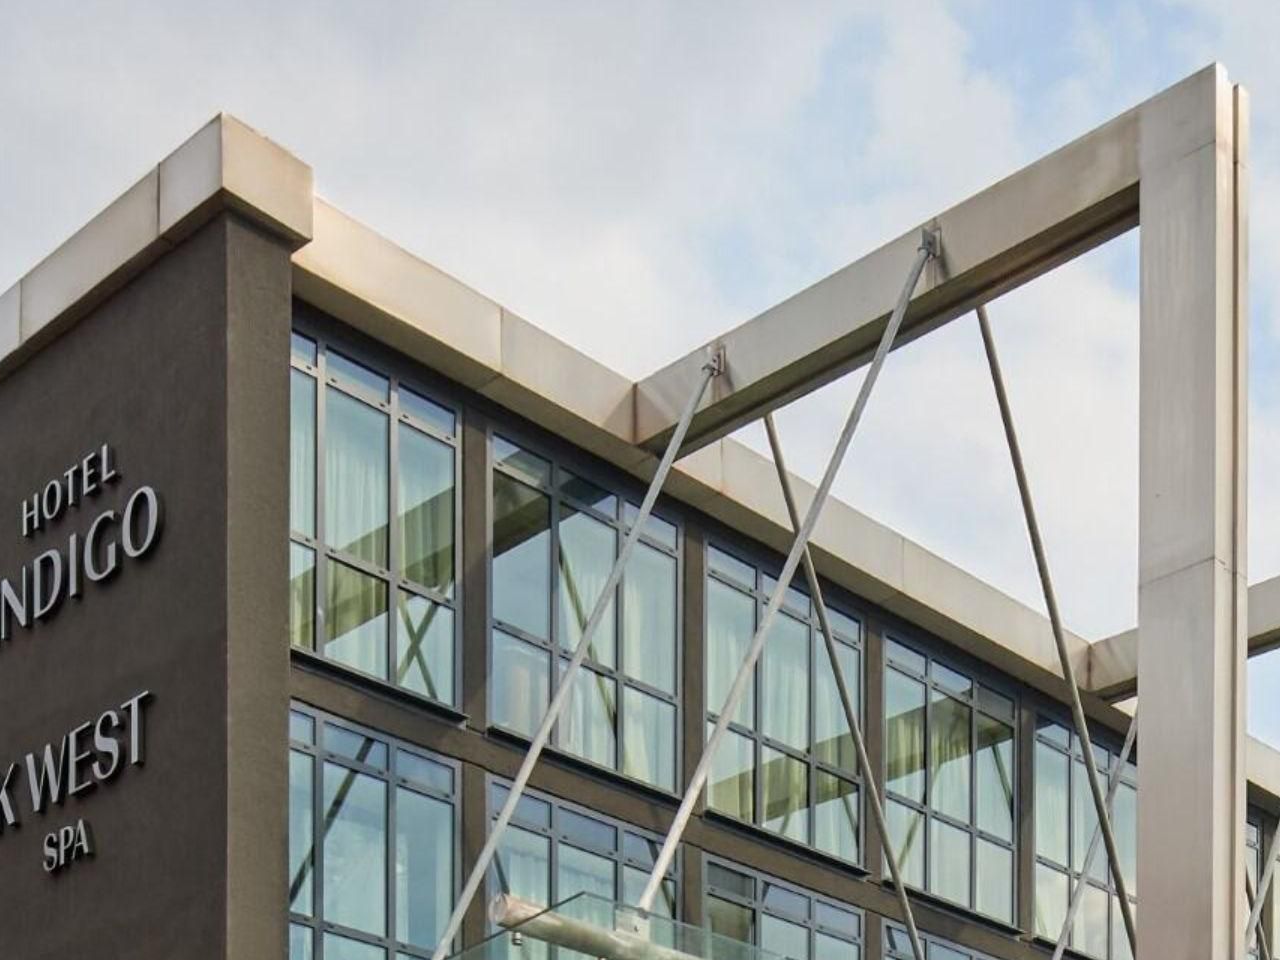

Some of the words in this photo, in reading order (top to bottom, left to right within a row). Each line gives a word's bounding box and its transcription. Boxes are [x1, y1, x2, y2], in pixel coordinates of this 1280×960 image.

[22, 443, 116, 537] HOTEL
[25, 690, 150, 812] WEST
[42, 818, 89, 872] SPA
